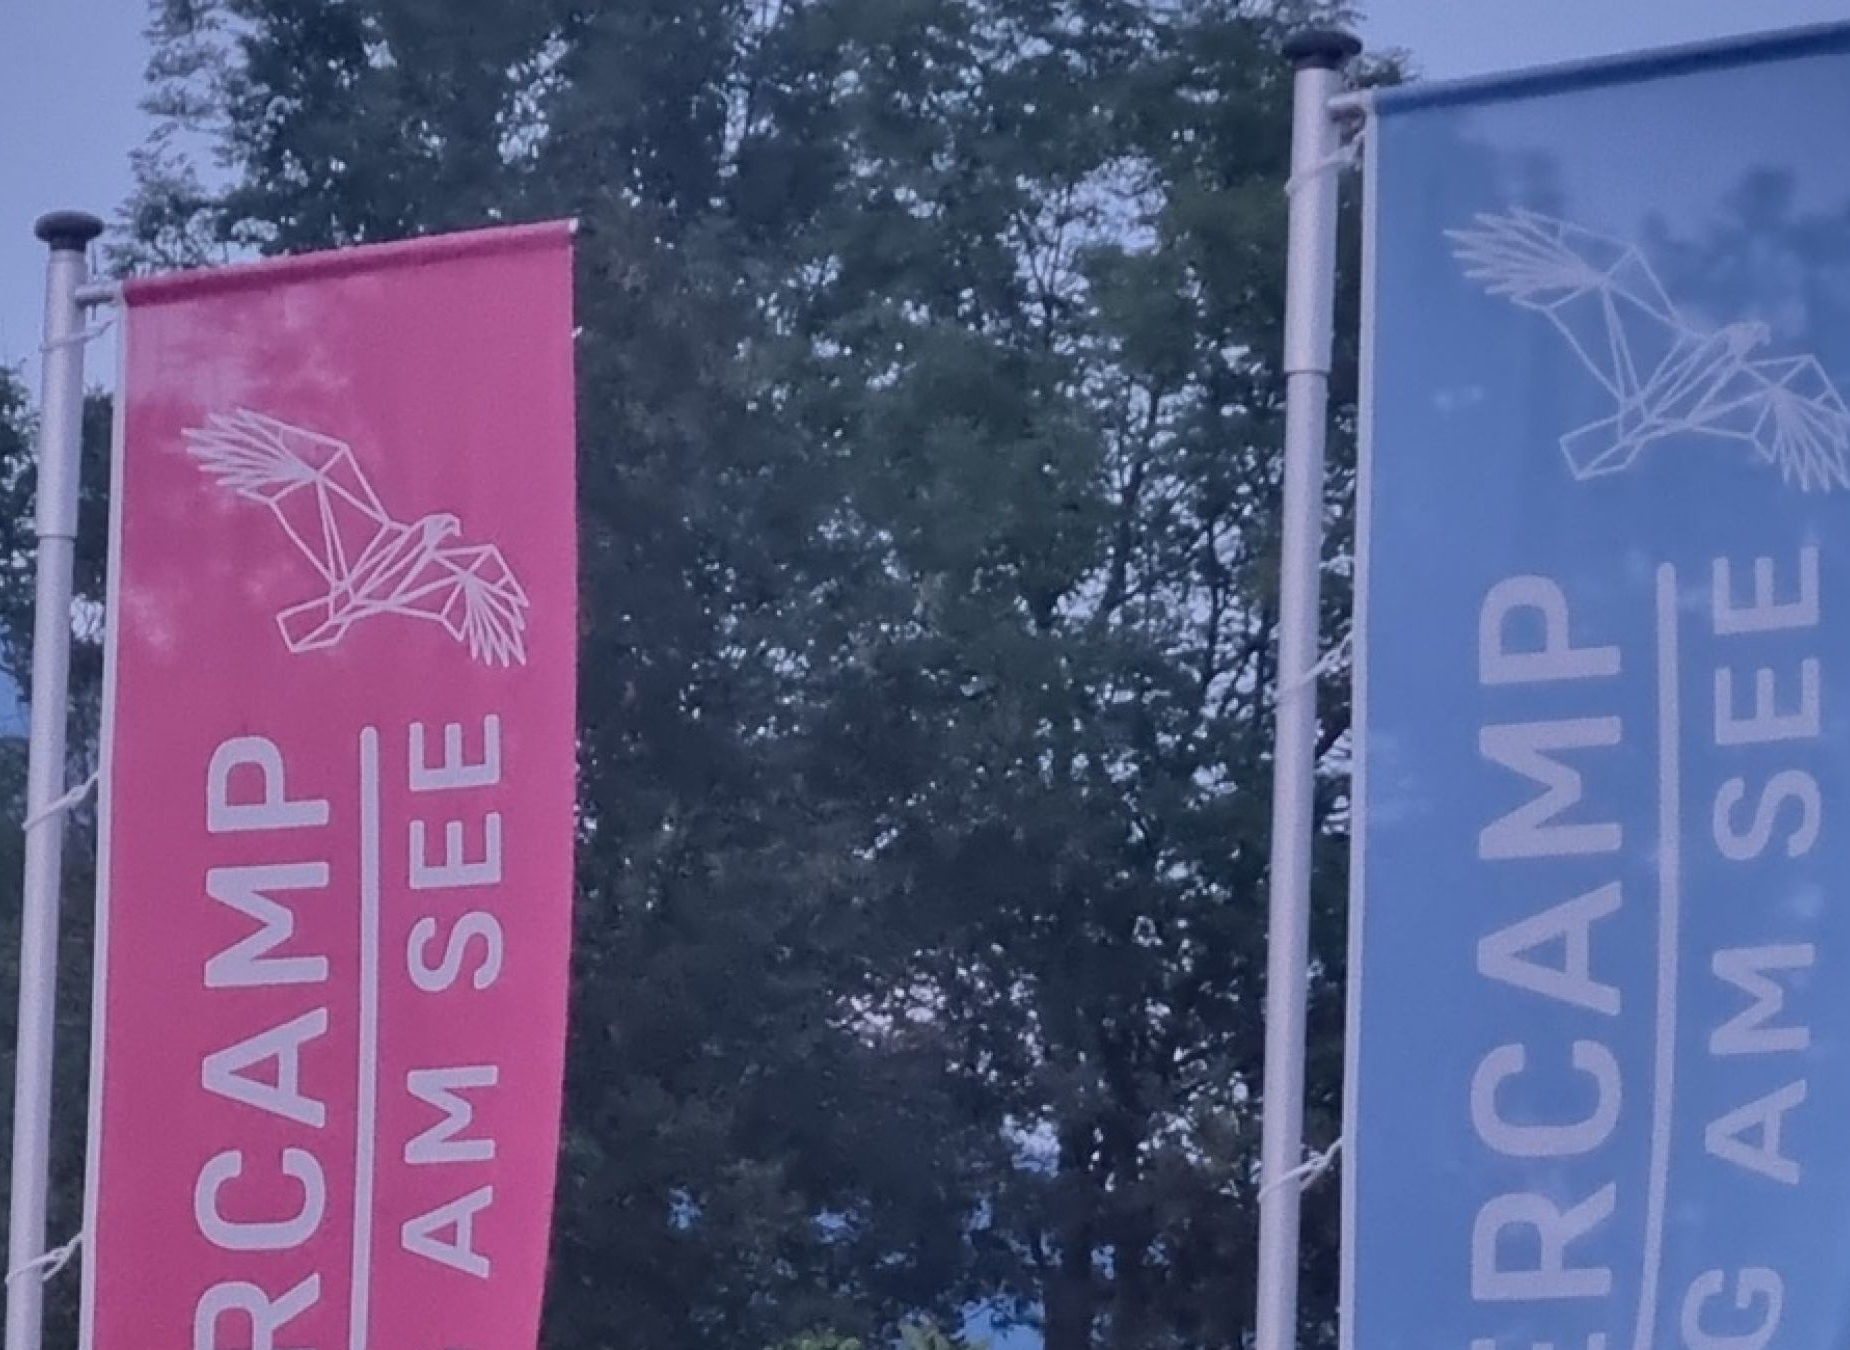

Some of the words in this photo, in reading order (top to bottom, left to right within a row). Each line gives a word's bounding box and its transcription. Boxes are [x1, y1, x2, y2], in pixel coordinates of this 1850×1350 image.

[1712, 545, 1824, 859] SEE
[406, 712, 503, 992] SEE
[402, 1063, 500, 1279] AM
[1705, 940, 1818, 1186] AM
